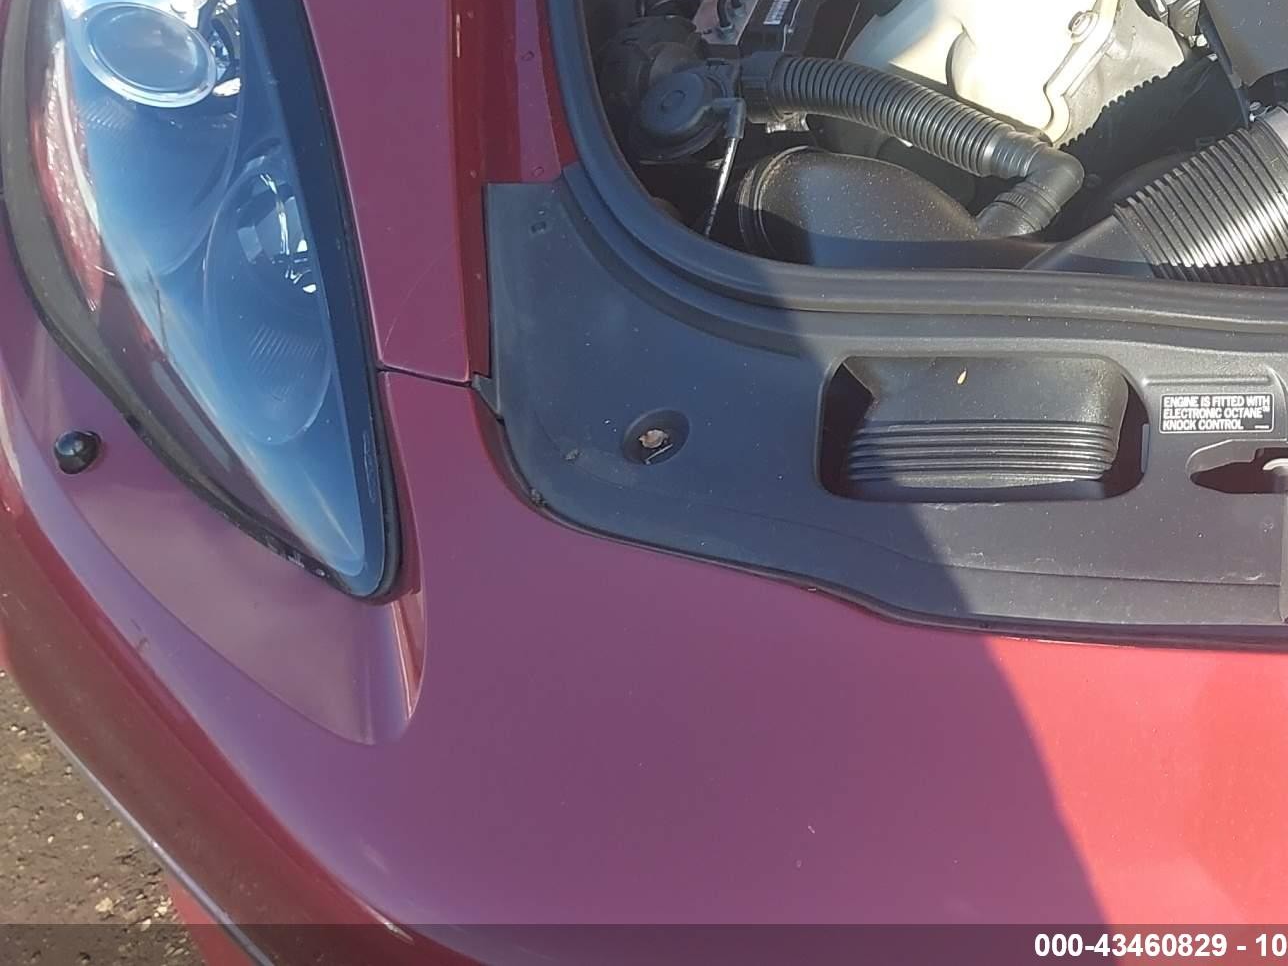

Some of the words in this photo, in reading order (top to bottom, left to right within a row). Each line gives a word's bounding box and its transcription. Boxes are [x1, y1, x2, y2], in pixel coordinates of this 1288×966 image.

[1163, 395, 1199, 408] ENGINE
[1200, 395, 1211, 407] IS
[1212, 395, 1245, 407] FITTED
[1246, 395, 1271, 407] WITH
[1163, 407, 1222, 419] ELECTRONIC
[1162, 419, 1197, 431] KNOCK
[1198, 419, 1244, 430] CONTROL
